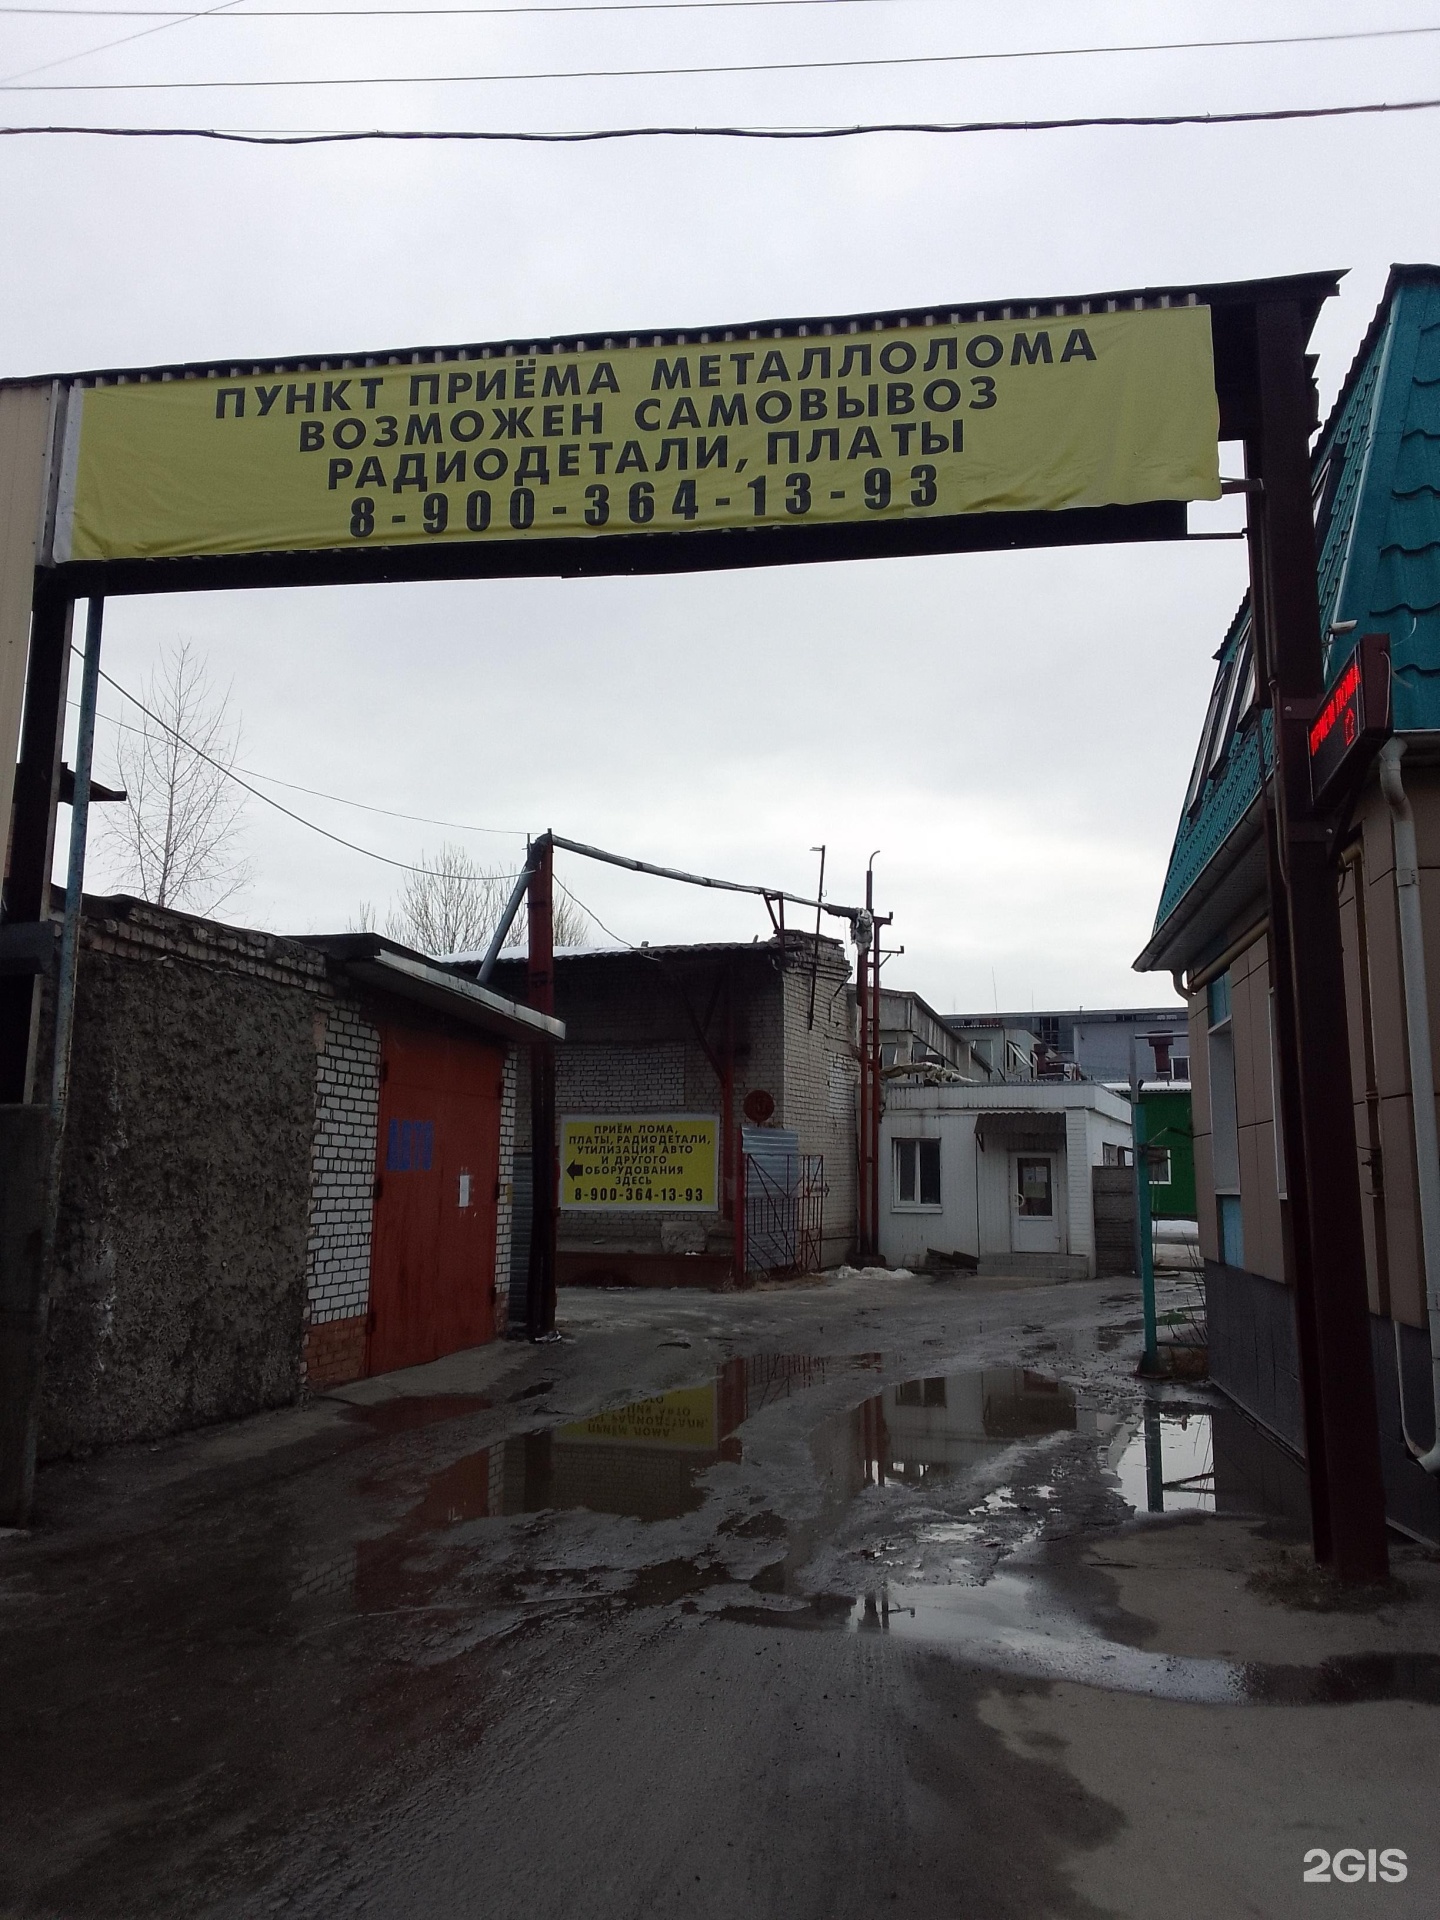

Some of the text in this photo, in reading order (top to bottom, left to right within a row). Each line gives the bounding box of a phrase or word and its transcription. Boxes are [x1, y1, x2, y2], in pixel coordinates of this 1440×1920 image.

[216, 328, 1098, 419] ПУНКТ ПРИЁМА МЕТАЛЛОЛОМА
[300, 376, 998, 453] ВОЗМОЖЕН САМОВЫВОЗ
[328, 419, 964, 494] РАДИОДЕТАЛИ, ПЛАТЫ
[350, 465, 938, 538] 8-900-364-13-93
[594, 1123, 678, 1135] ПРИЁМ ЛОМА,
[569, 1135, 711, 1145] ПЛАТЫ, РАДИОДЕТАЛИ,
[577, 1145, 693, 1155] УТИЛИЗАЦИЯ АВТО
[602, 1155, 667, 1166] И ДРУГОГО
[585, 1166, 684, 1176] ОБОРУДОВАНИЯ
[615, 1176, 652, 1187] ЗДЕСЬ
[574, 1187, 703, 1201] 8-900-364-13-93
